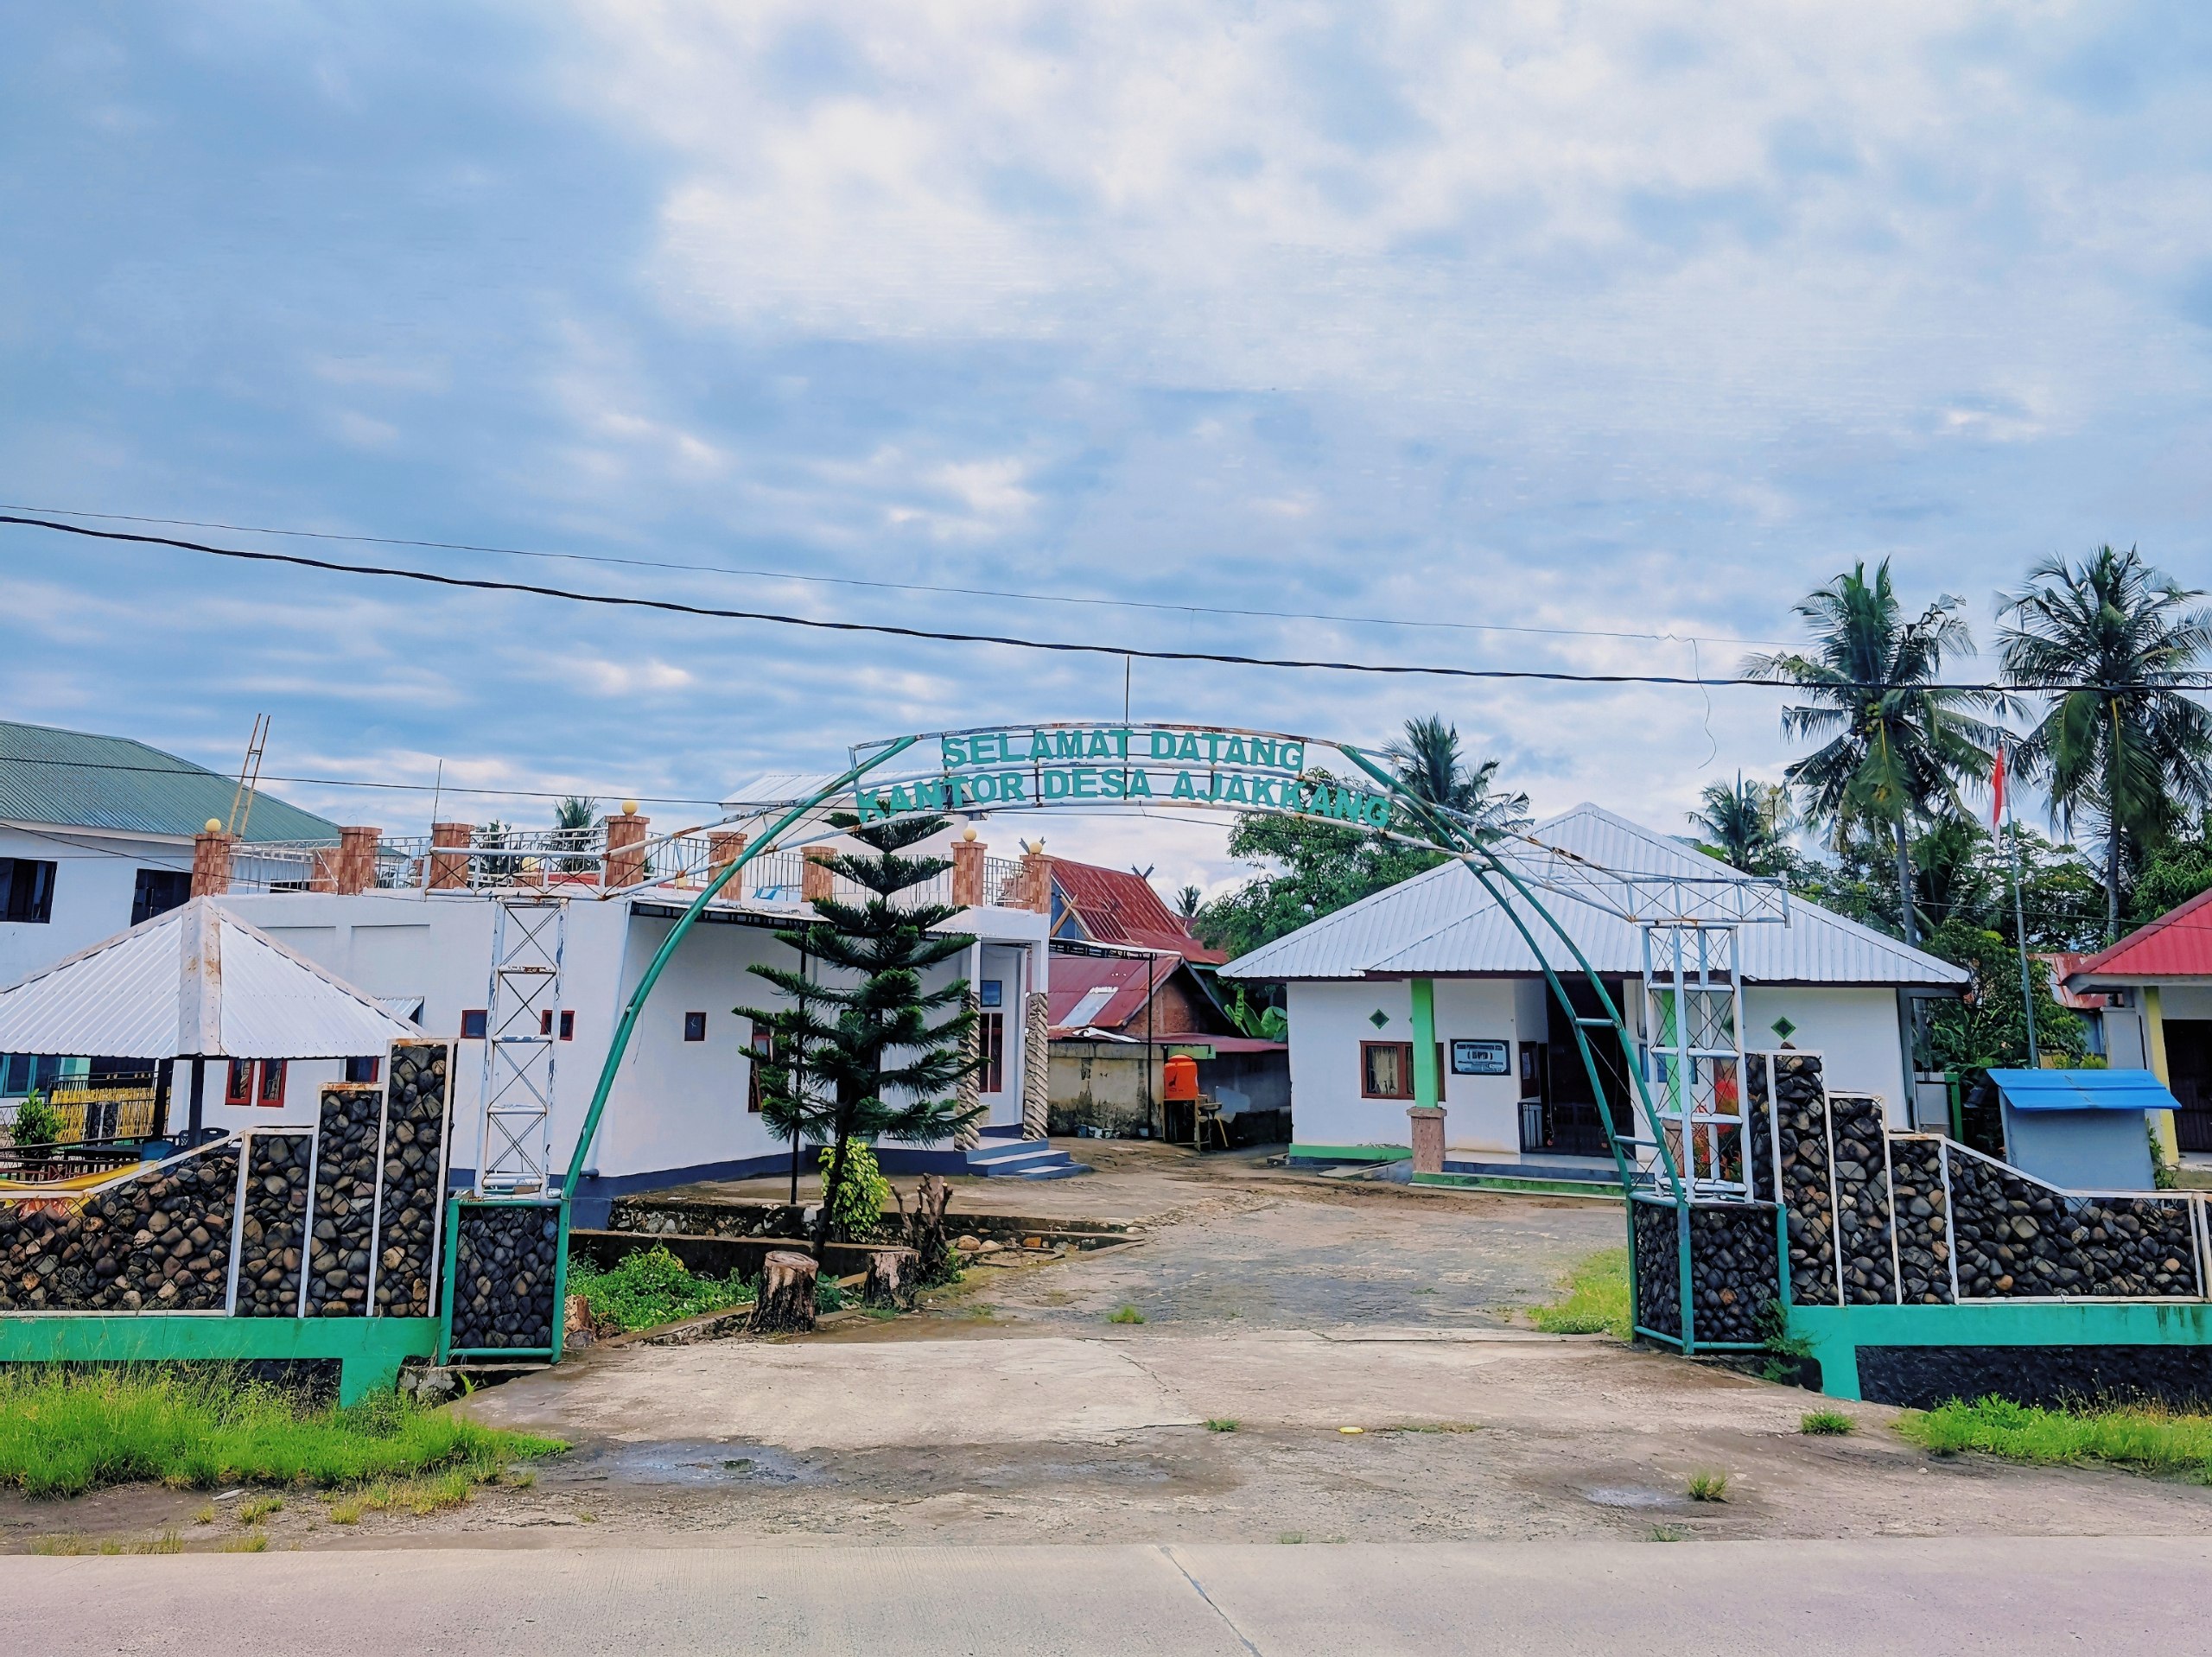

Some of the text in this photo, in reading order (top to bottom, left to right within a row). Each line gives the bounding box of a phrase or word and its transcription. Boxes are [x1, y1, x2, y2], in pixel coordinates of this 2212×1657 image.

[941, 729, 1305, 771] SELAMAT DATANG
[856, 768, 1392, 828] KANTOR DESA AJAKKANG
